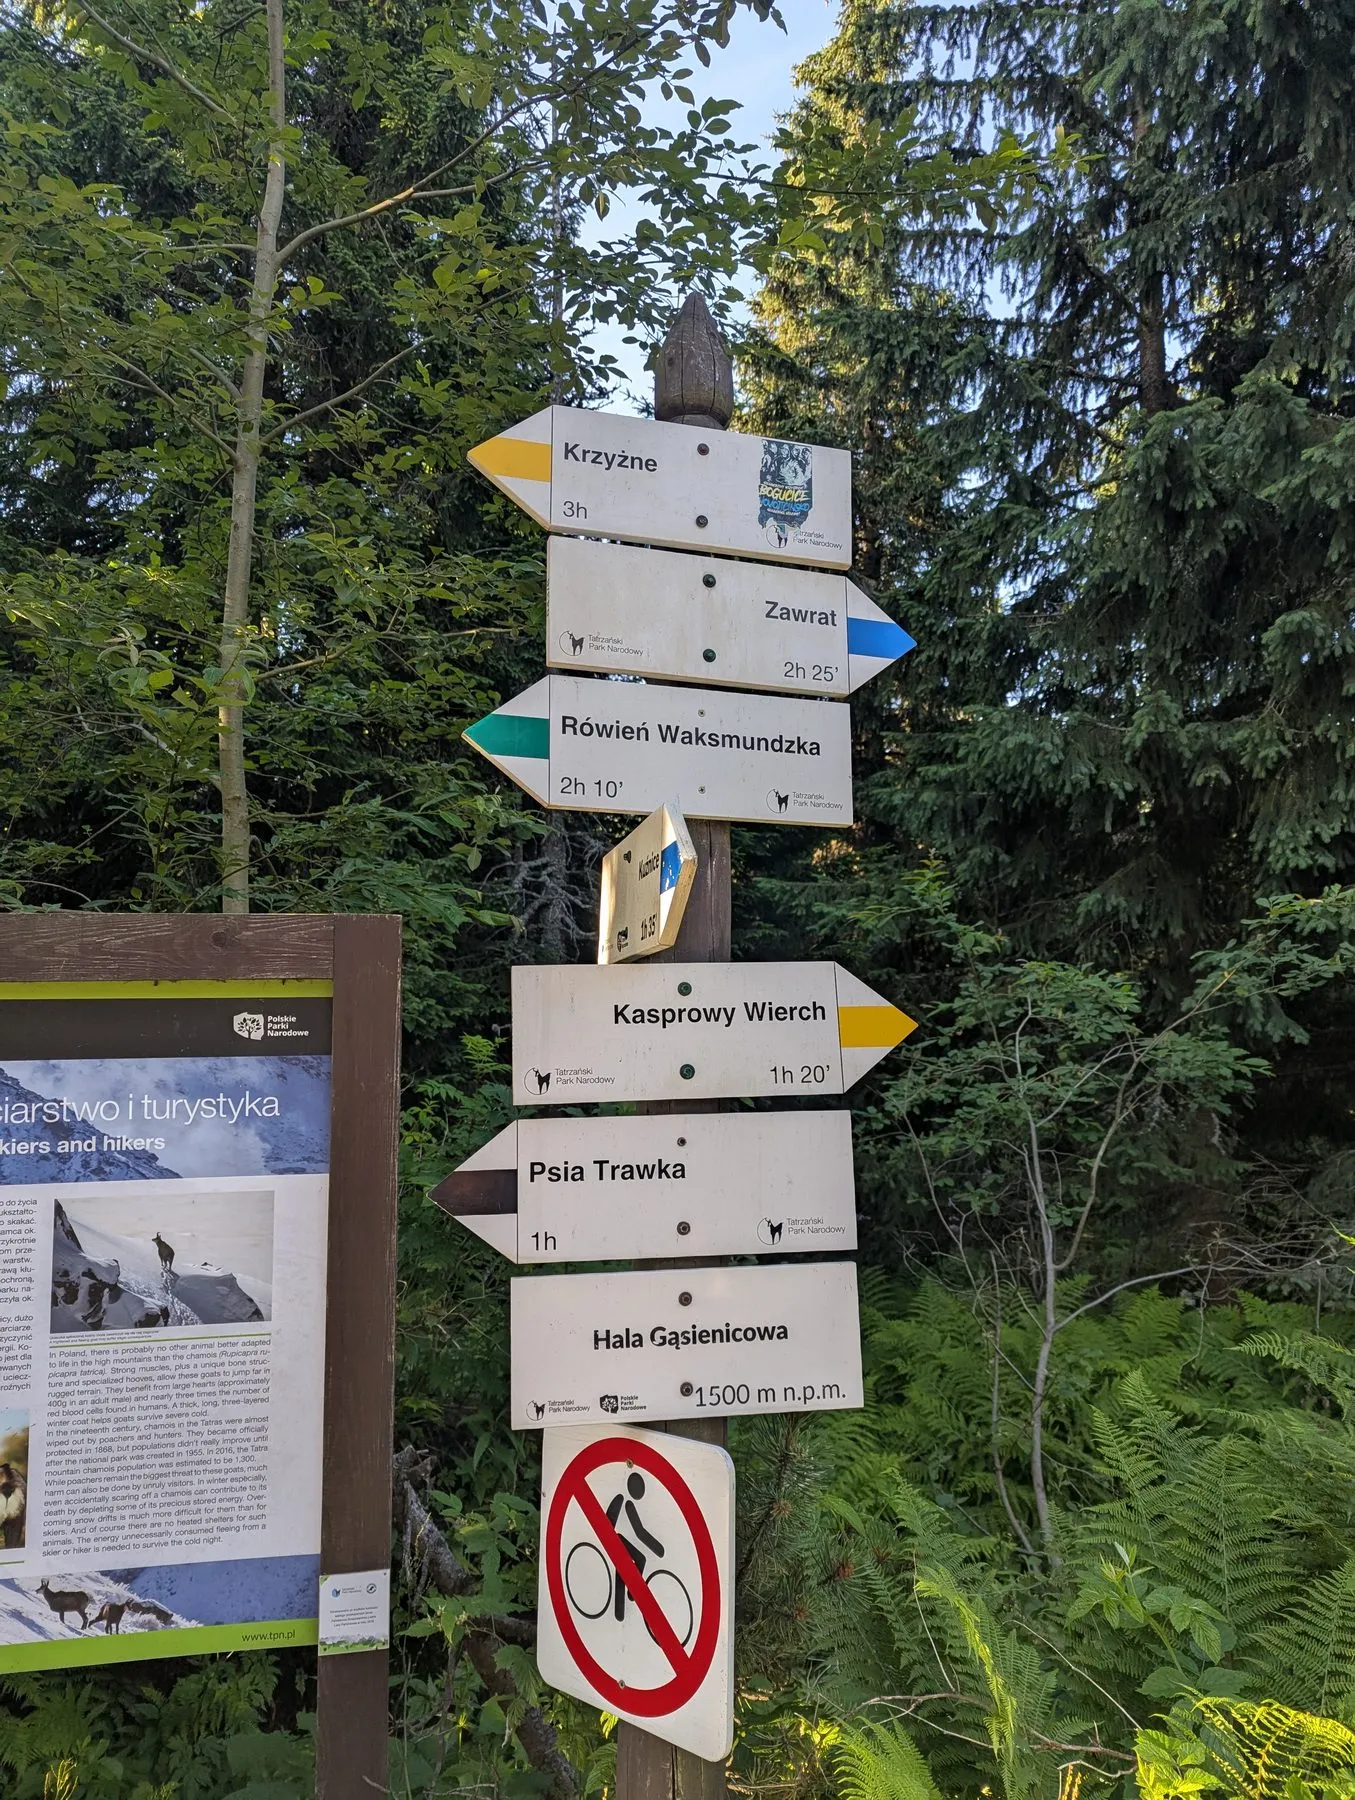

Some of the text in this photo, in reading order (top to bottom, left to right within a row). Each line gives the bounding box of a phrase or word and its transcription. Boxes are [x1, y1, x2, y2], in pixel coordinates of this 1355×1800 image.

[564, 442, 658, 472] Krzyżne
[759, 484, 810, 502] BOGUCICE
[562, 500, 588, 519] 3h
[793, 530, 825, 540] trzański
[809, 539, 843, 550] Narodowy
[765, 600, 837, 627] Zawrat
[588, 634, 624, 644] Tatrzański
[589, 643, 644, 656] Park Narodowy
[784, 661, 839, 682] 2h 25'
[561, 715, 821, 756] Rówień Waksmundzka
[560, 776, 623, 798] 2h 10'
[792, 791, 825, 800] Tatrzański
[810, 801, 843, 810] Narodowy
[638, 852, 660, 881] Kuźnice
[640, 918, 648, 940] 1h
[614, 1001, 826, 1028] Kasprowy Wierch
[555, 1068, 593, 1076] Tatrzański
[576, 1076, 616, 1085] Narodowy
[769, 1065, 830, 1084] 1h 20'
[0, 1090, 280, 1125] iarstwo i turystyka
[0, 1134, 166, 1155] kiers and hikers
[529, 1158, 686, 1183] Psia Trawka
[17, 1198, 37, 1207] życia
[786, 1217, 824, 1226] Tatrzański
[788, 1225, 846, 1235] Park Narodowy
[0, 1237, 36, 1246] zykrotnie
[531, 1231, 557, 1251] 1h
[0, 1296, 19, 1304] czyła
[0, 1334, 33, 1343] zyczynić
[593, 1322, 789, 1350] Hala Gąsienicowa
[90, 1347, 109, 1356] there
[121, 1345, 154, 1356] probably
[168, 1343, 188, 1351] other
[190, 1341, 214, 1350] animal
[217, 1340, 238, 1348] better
[241, 1338, 270, 1349] adapted
[0, 1363, 32, 1372] ewanych
[0, 1383, 31, 1391] roźnych
[695, 1382, 847, 1407] 1500 m n.p.m.
[46, 1409, 59, 1417] red
[62, 1408, 83, 1416] blood
[85, 1406, 103, 1415] cells
[105, 1405, 126, 1414] found
[221, 1396, 269, 1408] three-layered
[45, 1438, 69, 1449] wiped
[71, 1437, 84, 1445] out
[87, 1436, 96, 1446] by
[98, 1434, 134, 1445] poachers
[136, 1433, 151, 1441] and
[186, 1429, 204, 1439] They
[207, 1427, 236, 1436] became
[239, 1425, 268, 1436] officially
[44, 1467, 80, 1477] mountain
[82, 1464, 114, 1474] chamois
[116, 1462, 156, 1473] population
[175, 1458, 211, 1468] estimated
[44, 1478, 65, 1487] While
[66, 1475, 102, 1487] poachers
[103, 1473, 128, 1482] remain
[129, 1472, 142, 1480] the
[142, 1470, 170, 1481] biggest
[171, 1469, 192, 1478] threat
[201, 1467, 222, 1475] these
[246, 1464, 267, 1472] much
[42, 1517, 71, 1528] coming
[97, 1513, 117, 1522] drifts
[128, 1511, 149, 1520] much
[174, 1507, 201, 1516] difficult
[216, 1504, 235, 1513] them
[237, 1503, 254, 1512] than
[42, 1547, 60, 1556] skier
[72, 1545, 91, 1554] hiker
[101, 1542, 130, 1551] needed
[142, 1539, 168, 1548] survive
[170, 1538, 182, 1546] the
[184, 1536, 200, 1545] cold
[241, 1629, 296, 1642] www.tpn.pl
